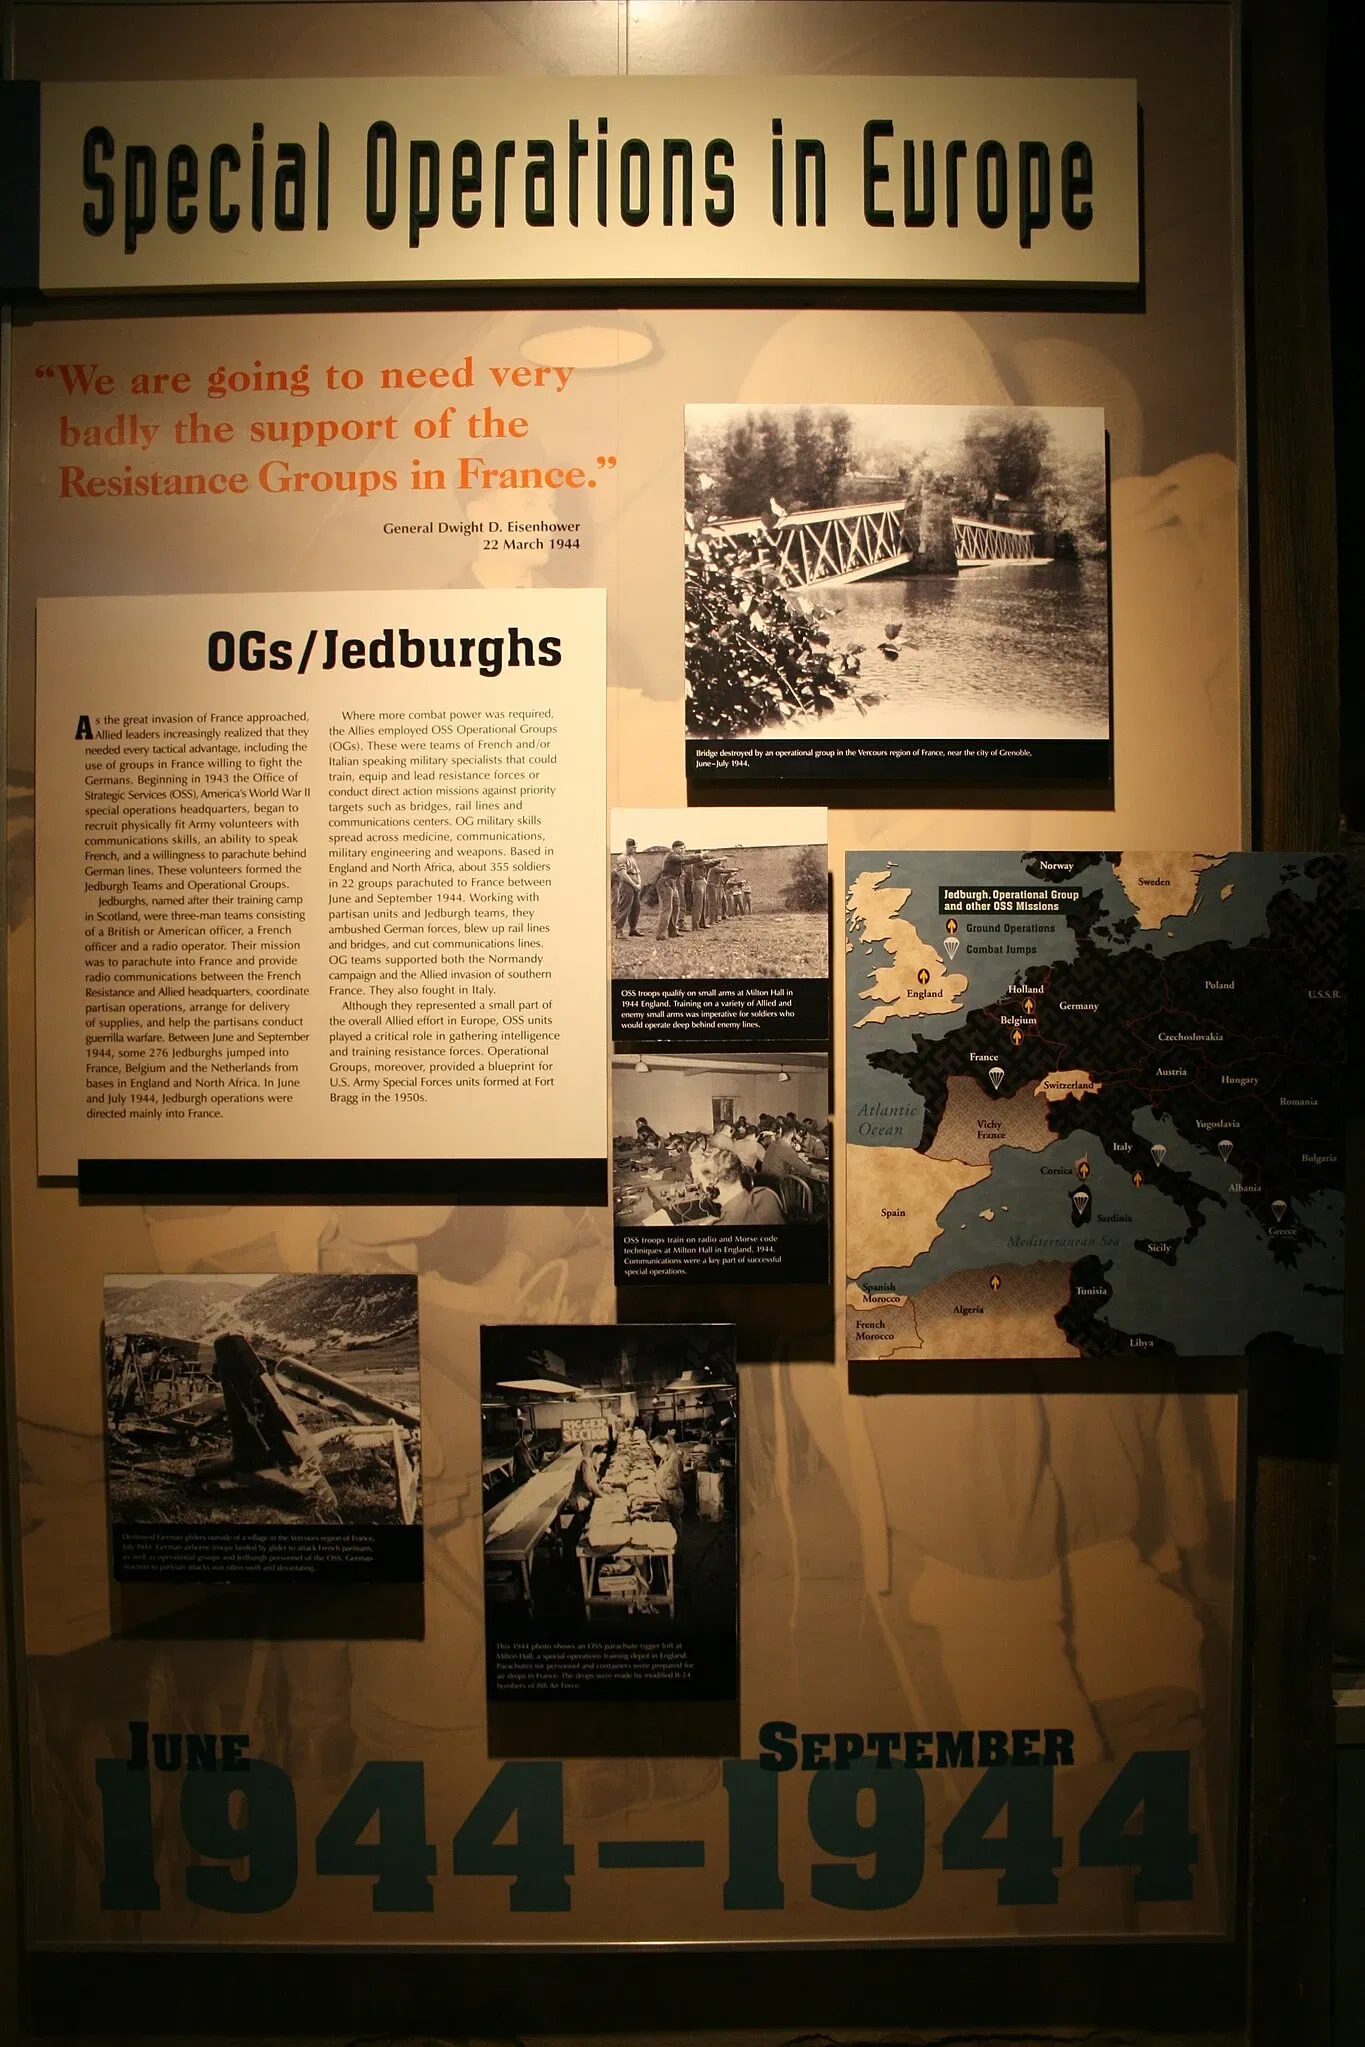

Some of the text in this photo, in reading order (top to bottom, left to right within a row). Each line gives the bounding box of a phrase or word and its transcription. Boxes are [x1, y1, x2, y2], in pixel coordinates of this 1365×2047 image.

[82, 116, 1096, 254] Special Operations in Europe
[34, 355, 574, 398] “We are going to need very
[58, 406, 528, 450] badly the support of the
[58, 455, 616, 497] Resistance Groups in France.”
[383, 520, 580, 536] General Dwight D. Eisenhower
[483, 537, 580, 549] 22 March 1944
[208, 627, 561, 677] OGs/Jedburghs
[341, 710, 375, 720] Where
[408, 709, 446, 719] combat
[449, 712, 480, 721] power
[508, 708, 553, 721] required,
[95, 726, 307, 740] Allied leaders increasingly realized that they
[329, 723, 557, 738] the Allies employed OSS Operational Groups
[85, 741, 307, 756] needed every tactical advantage, including the
[696, 749, 718, 758] Bridge
[719, 749, 753, 758] destroyed
[754, 748, 763, 758] by
[775, 748, 813, 758] operational
[814, 750, 835, 758] group
[845, 748, 856, 756] the
[964, 748, 975, 756] the
[998, 748, 1032, 756] Grenoble,
[105, 759, 116, 769] of
[119, 761, 154, 772] groups
[158, 759, 167, 768] in
[171, 759, 204, 768] France
[207, 758, 242, 770] willing
[245, 759, 255, 767] to
[259, 757, 281, 769] fight
[286, 757, 302, 766] the
[1040, 860, 1073, 872] Norway
[1138, 877, 1170, 885] Sweden
[944, 889, 1078, 901] Jedburgh, Operational Group
[944, 901, 1059, 910] and other OSS Missions
[966, 923, 1055, 934] Ground Operations
[966, 944, 1036, 955] Combat Jumps
[1008, 984, 1044, 993] Holland
[1205, 980, 1234, 989] Poland
[638, 990, 660, 998] troops
[661, 989, 685, 998] qualify
[770, 988, 784, 996] Hall
[906, 988, 943, 1000] England
[1059, 1001, 1098, 1012] Germany
[1000, 1015, 1036, 1026] Belgium
[1158, 1032, 1223, 1041] Czechoslovakia
[970, 1052, 998, 1061] France
[1156, 1067, 1186, 1075] Austria
[1044, 1080, 1096, 1092] Switzerland
[1221, 1075, 1258, 1086] Hungary
[1280, 1096, 1318, 1105] Romania
[856, 1102, 917, 1116] Atlantic
[858, 1122, 902, 1135] Ocean
[976, 1119, 1002, 1130] Vichy
[1195, 1119, 1240, 1130] Yugoslavia
[977, 1129, 1006, 1139] France
[1113, 1142, 1132, 1153] Italy
[1302, 1153, 1337, 1164] Bulgaria
[1040, 1166, 1072, 1175] Corsica
[1228, 1183, 1261, 1192] Albania
[880, 1208, 906, 1219] Spain
[1096, 1213, 1132, 1222] Sardinia
[1268, 1227, 1296, 1235] Greece
[641, 1237, 664, 1245] troops
[1007, 1234, 1120, 1247] Mediterranean Sea
[1147, 1243, 1172, 1254] Sicily
[862, 1281, 896, 1293] Spanish
[1077, 1286, 1106, 1295] Tunisia
[862, 1294, 902, 1304] Morocco
[952, 1305, 984, 1316] Algeria
[856, 1319, 885, 1328] French
[855, 1331, 894, 1340] Morocco
[1130, 1338, 1153, 1346] Libya
